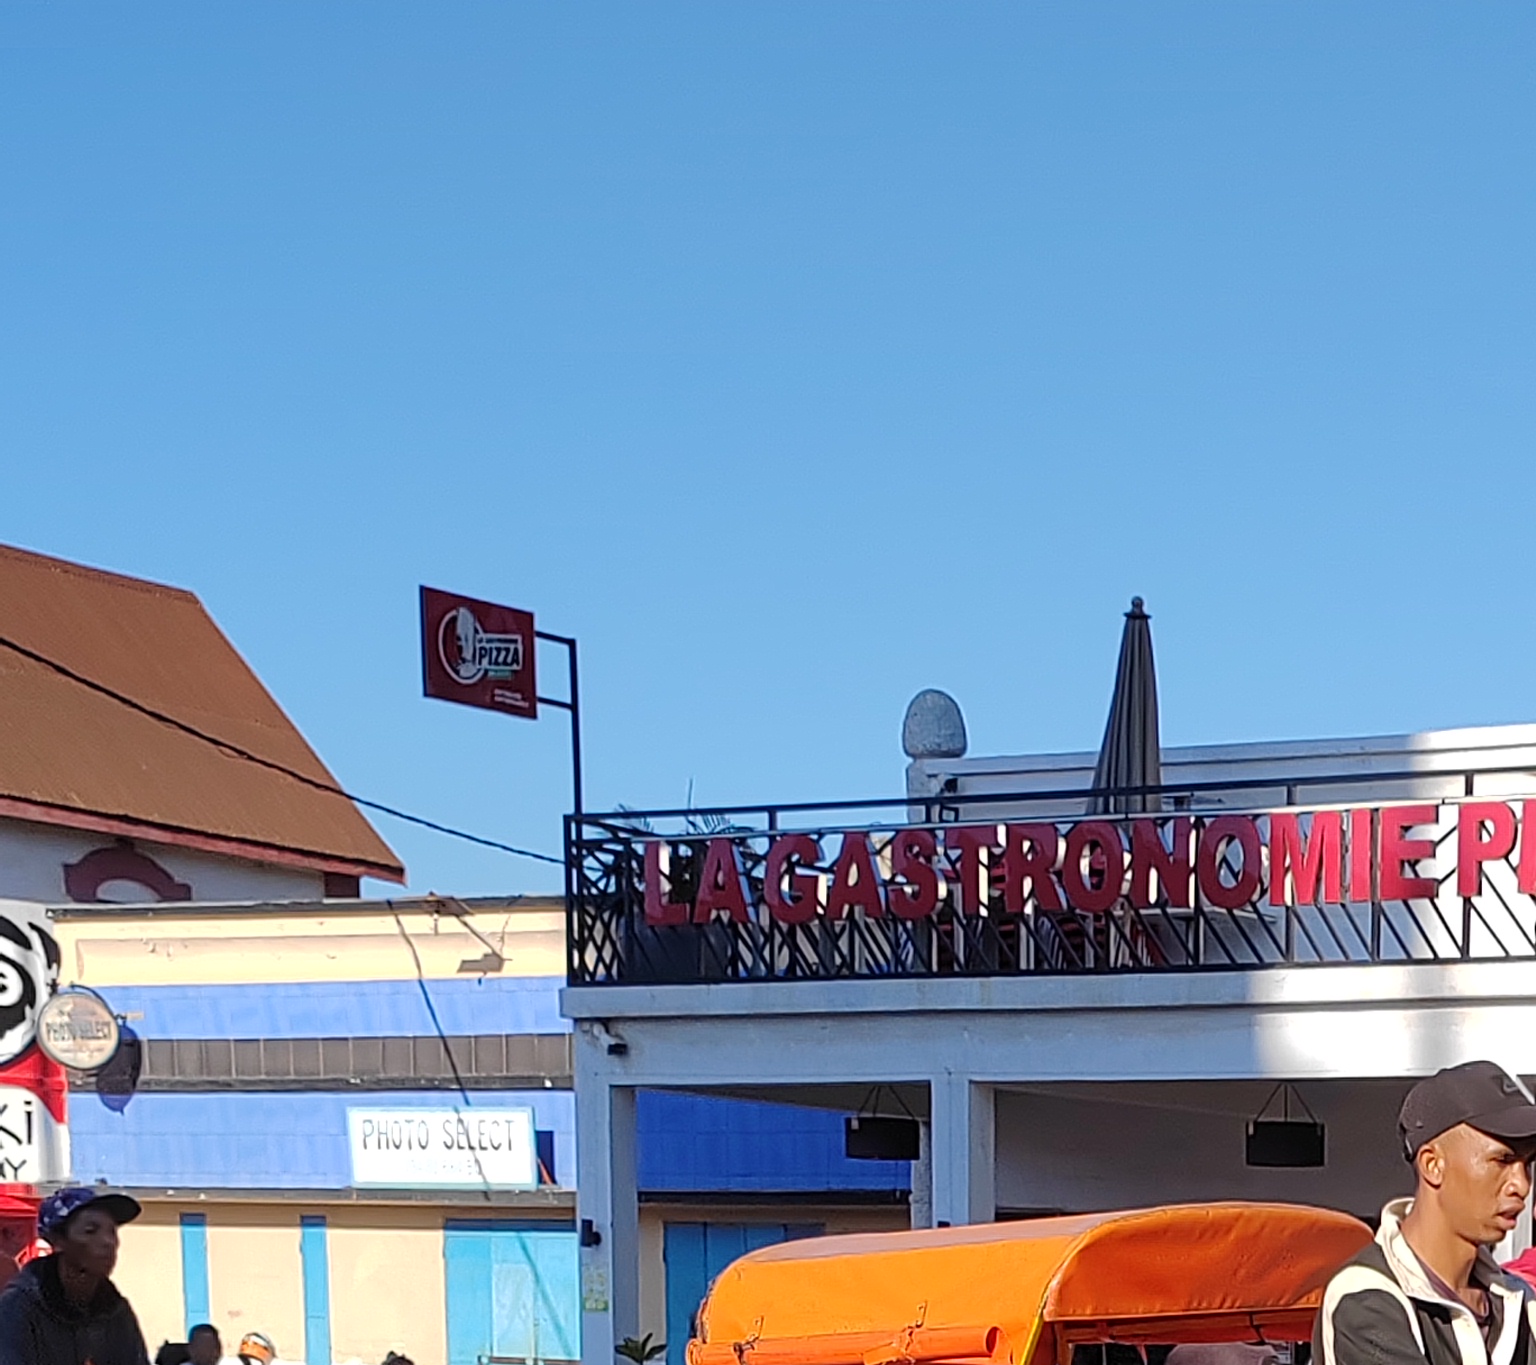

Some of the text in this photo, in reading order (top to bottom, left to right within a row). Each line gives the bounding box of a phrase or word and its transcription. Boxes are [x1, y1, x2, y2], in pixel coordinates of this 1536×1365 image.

[478, 645, 520, 667] PIZZA
[644, 838, 749, 926] LA
[764, 804, 1438, 924] GASTRONOMIE
[363, 1119, 515, 1151] PHOTO SELECT
